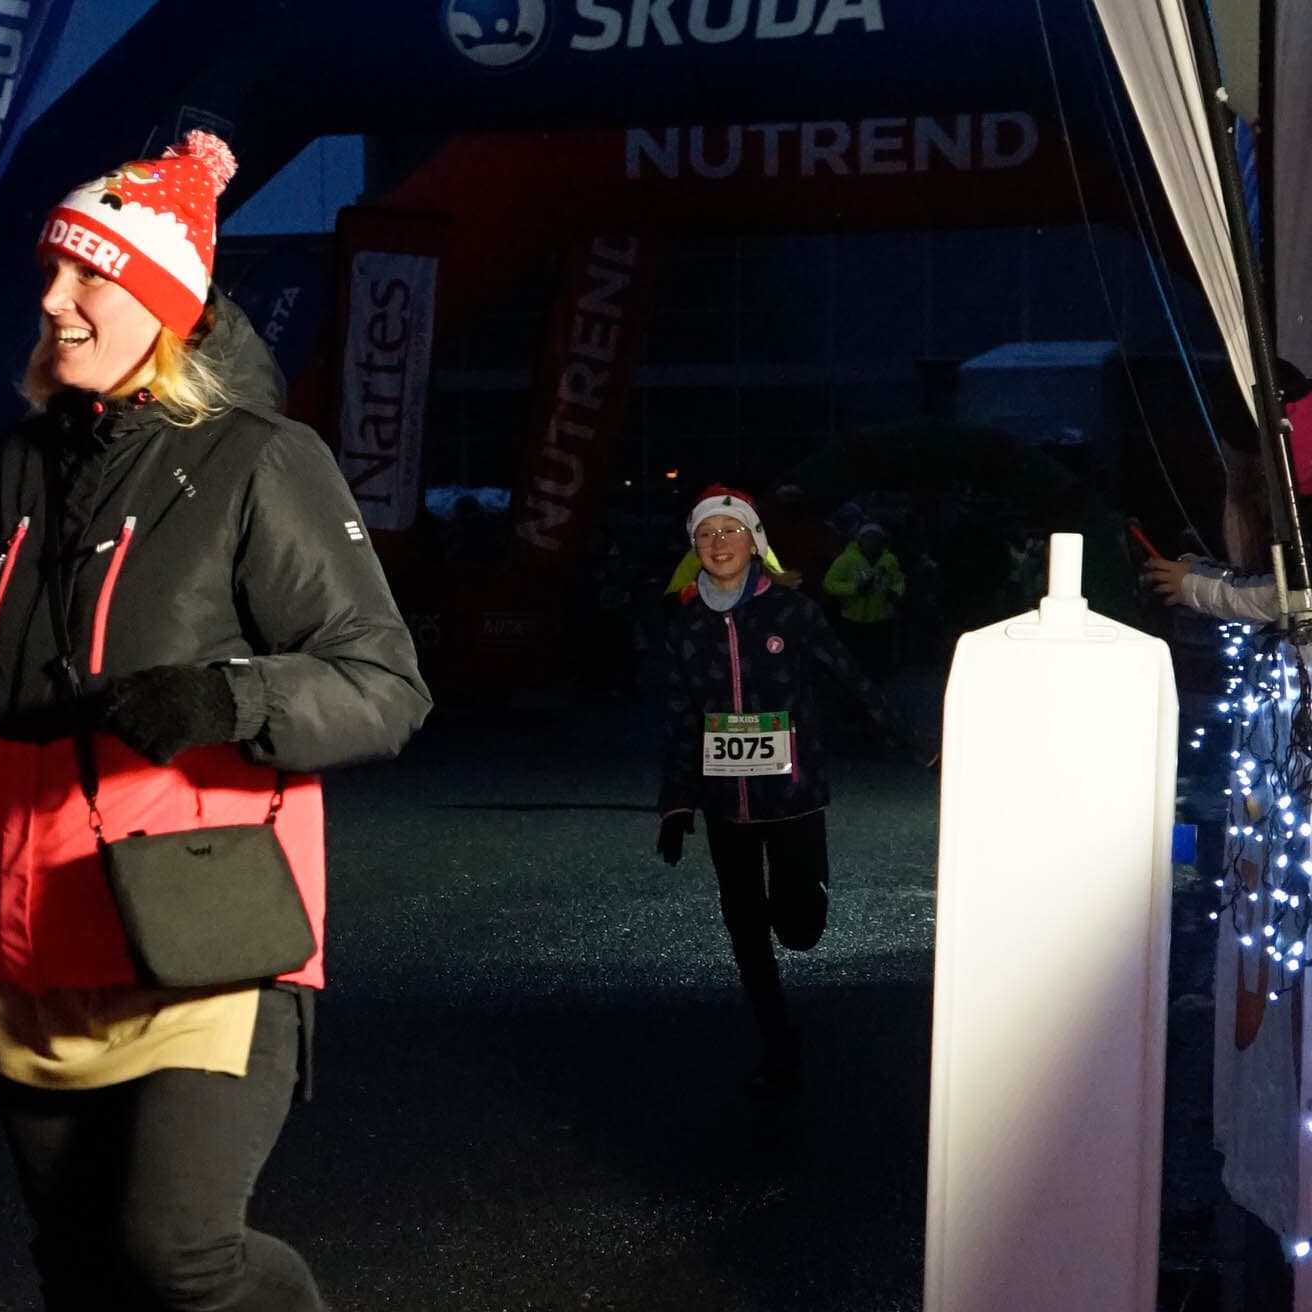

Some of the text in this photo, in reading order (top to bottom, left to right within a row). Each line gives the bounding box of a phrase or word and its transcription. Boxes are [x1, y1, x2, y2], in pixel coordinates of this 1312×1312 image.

[624, 109, 1040, 181] NUTREND
[48, 219, 131, 278] DEER!
[345, 279, 411, 505] Nartes
[714, 736, 774, 760] 3075
